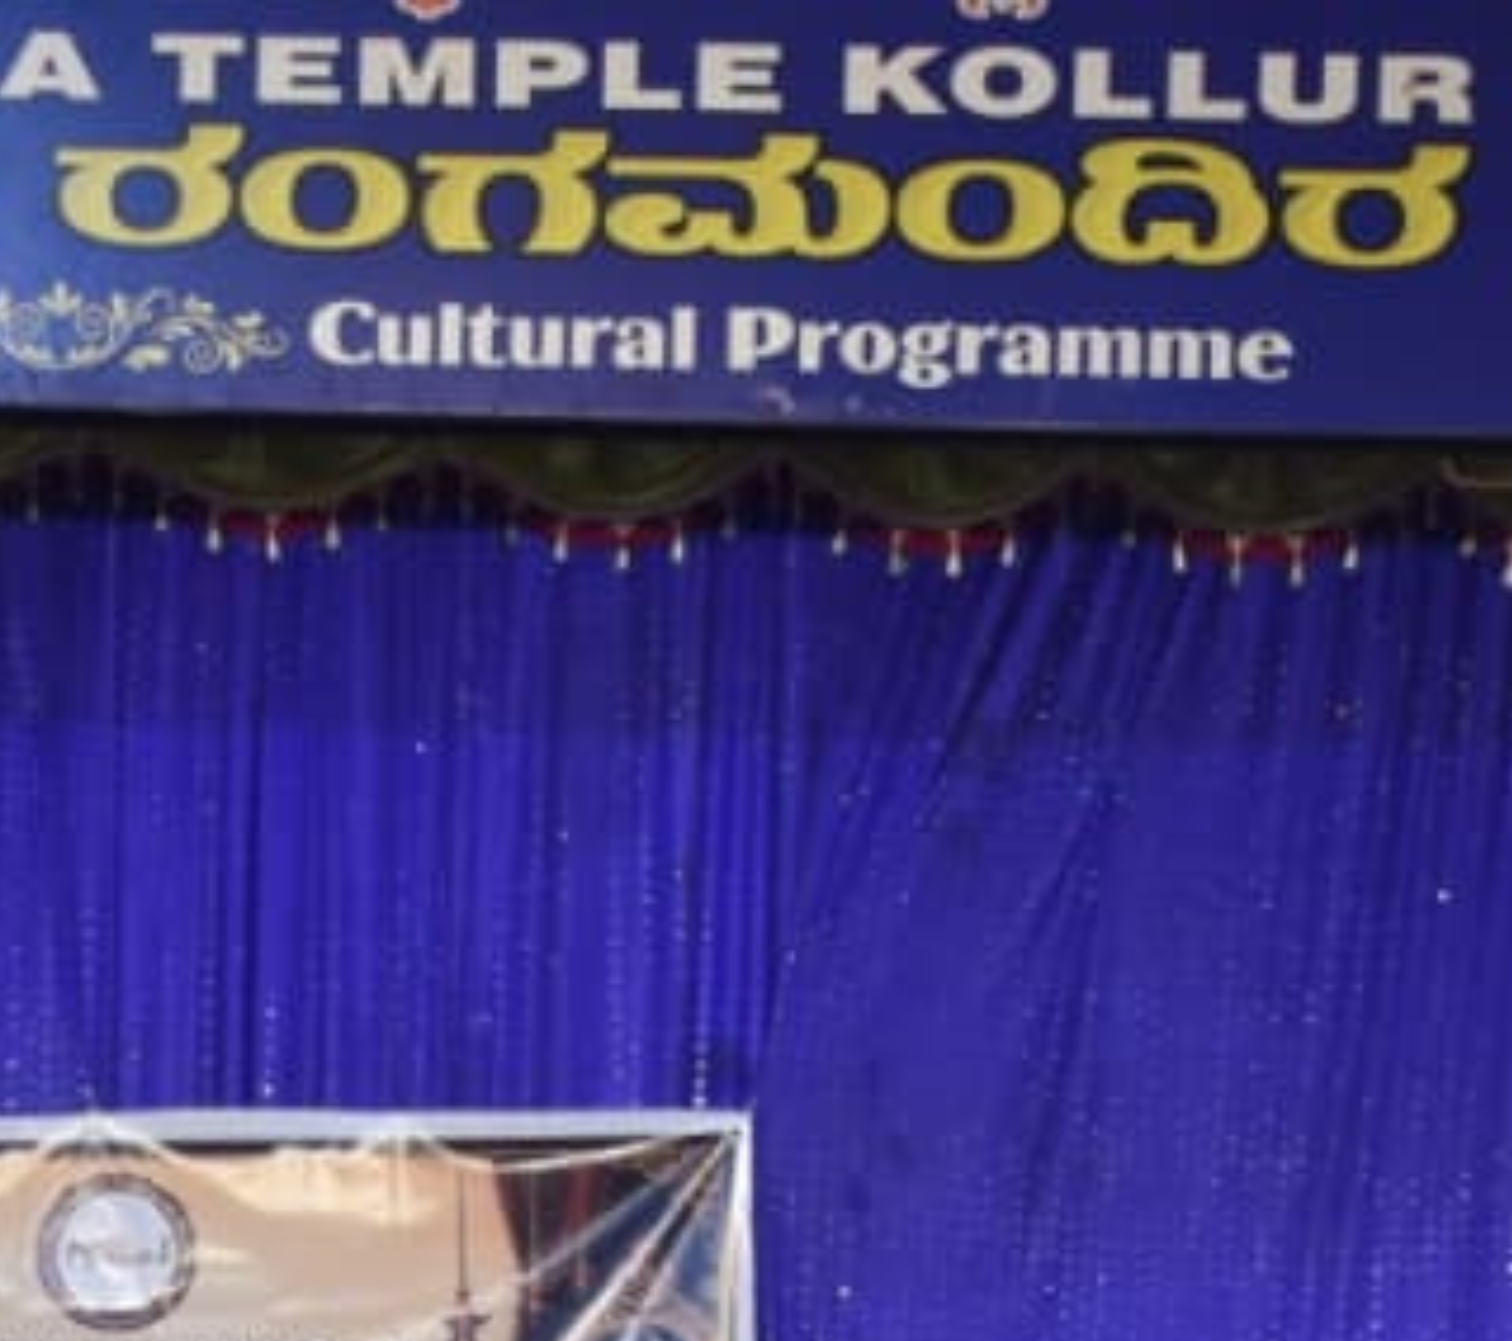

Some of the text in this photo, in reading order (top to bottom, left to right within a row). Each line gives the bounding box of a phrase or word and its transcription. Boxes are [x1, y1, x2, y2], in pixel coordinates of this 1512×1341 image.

[151, 32, 782, 112] TEMPLE
[843, 44, 1473, 124] KOLLUR
[54, 123, 1470, 267] ರಂಗಮಂದಿರ
[307, 299, 1295, 388] Cultural Programme
